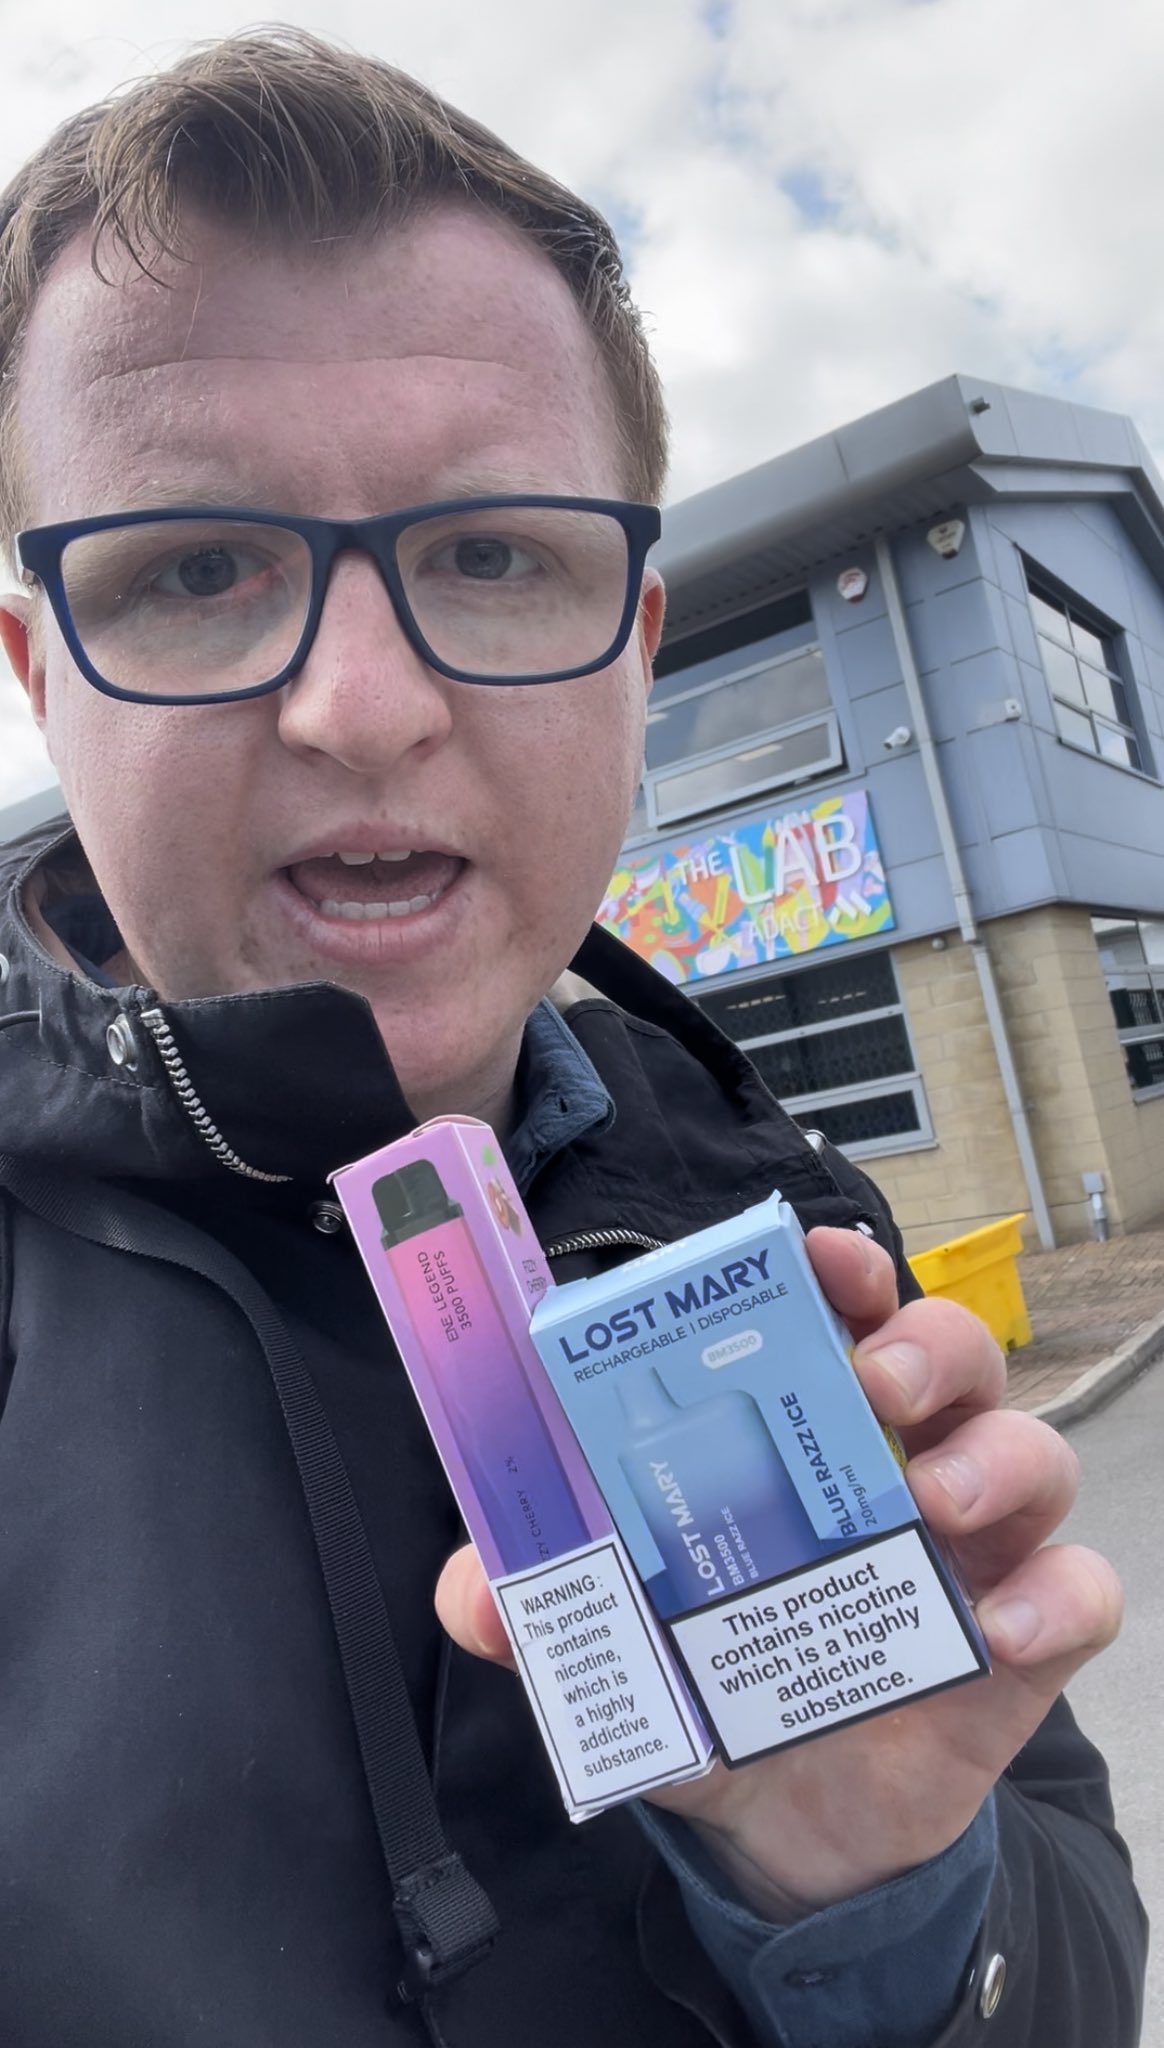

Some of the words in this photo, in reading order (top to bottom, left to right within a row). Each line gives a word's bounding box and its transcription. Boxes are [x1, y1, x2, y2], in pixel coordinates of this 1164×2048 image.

[677, 850, 724, 885] THE
[729, 814, 863, 905] LAB
[749, 905, 824, 943] ADACT
[418, 1252, 447, 1311] LEGEND
[434, 1251, 458, 1294] PUFFS
[452, 1297, 472, 1330] 3500
[559, 1299, 656, 1364] LOST
[664, 1249, 770, 1319] MARY
[574, 1326, 687, 1383] RECHARGEABLE
[699, 1282, 788, 1330] DISPOSABLE
[707, 1335, 757, 1362] BM3500
[780, 1392, 807, 1427] ICE
[797, 1428, 832, 1482] RAZZ
[517, 1490, 541, 1537] CHERRY
[649, 1461, 694, 1528] MARY
[720, 1505, 734, 1524] ICE
[822, 1484, 857, 1537] BLUE
[840, 1465, 878, 1527] 20mg/ml
[714, 1534, 745, 1586] BM3500
[729, 1524, 746, 1551] RAZZ
[681, 1532, 726, 1596] LOST
[741, 1552, 759, 1579] BLUE
[524, 1620, 555, 1640] This
[558, 1592, 618, 1634] product
[723, 1605, 778, 1636] This
[782, 1562, 879, 1619] product
[547, 1624, 611, 1659] contains
[711, 1620, 813, 1670] contains
[818, 1579, 917, 1630] nicotine
[554, 1649, 621, 1683] nicotine,
[720, 1655, 792, 1695] which
[794, 1646, 819, 1666] is
[825, 1638, 841, 1656] a
[844, 1605, 920, 1648] highly
[563, 1674, 610, 1705] which
[612, 1670, 628, 1686] is
[777, 1649, 887, 1702] addictive
[781, 1670, 914, 1729] substance.
[574, 1714, 585, 1728] a
[587, 1693, 635, 1724] highly
[580, 1715, 649, 1753] addictive
[584, 1737, 669, 1777] substance.
